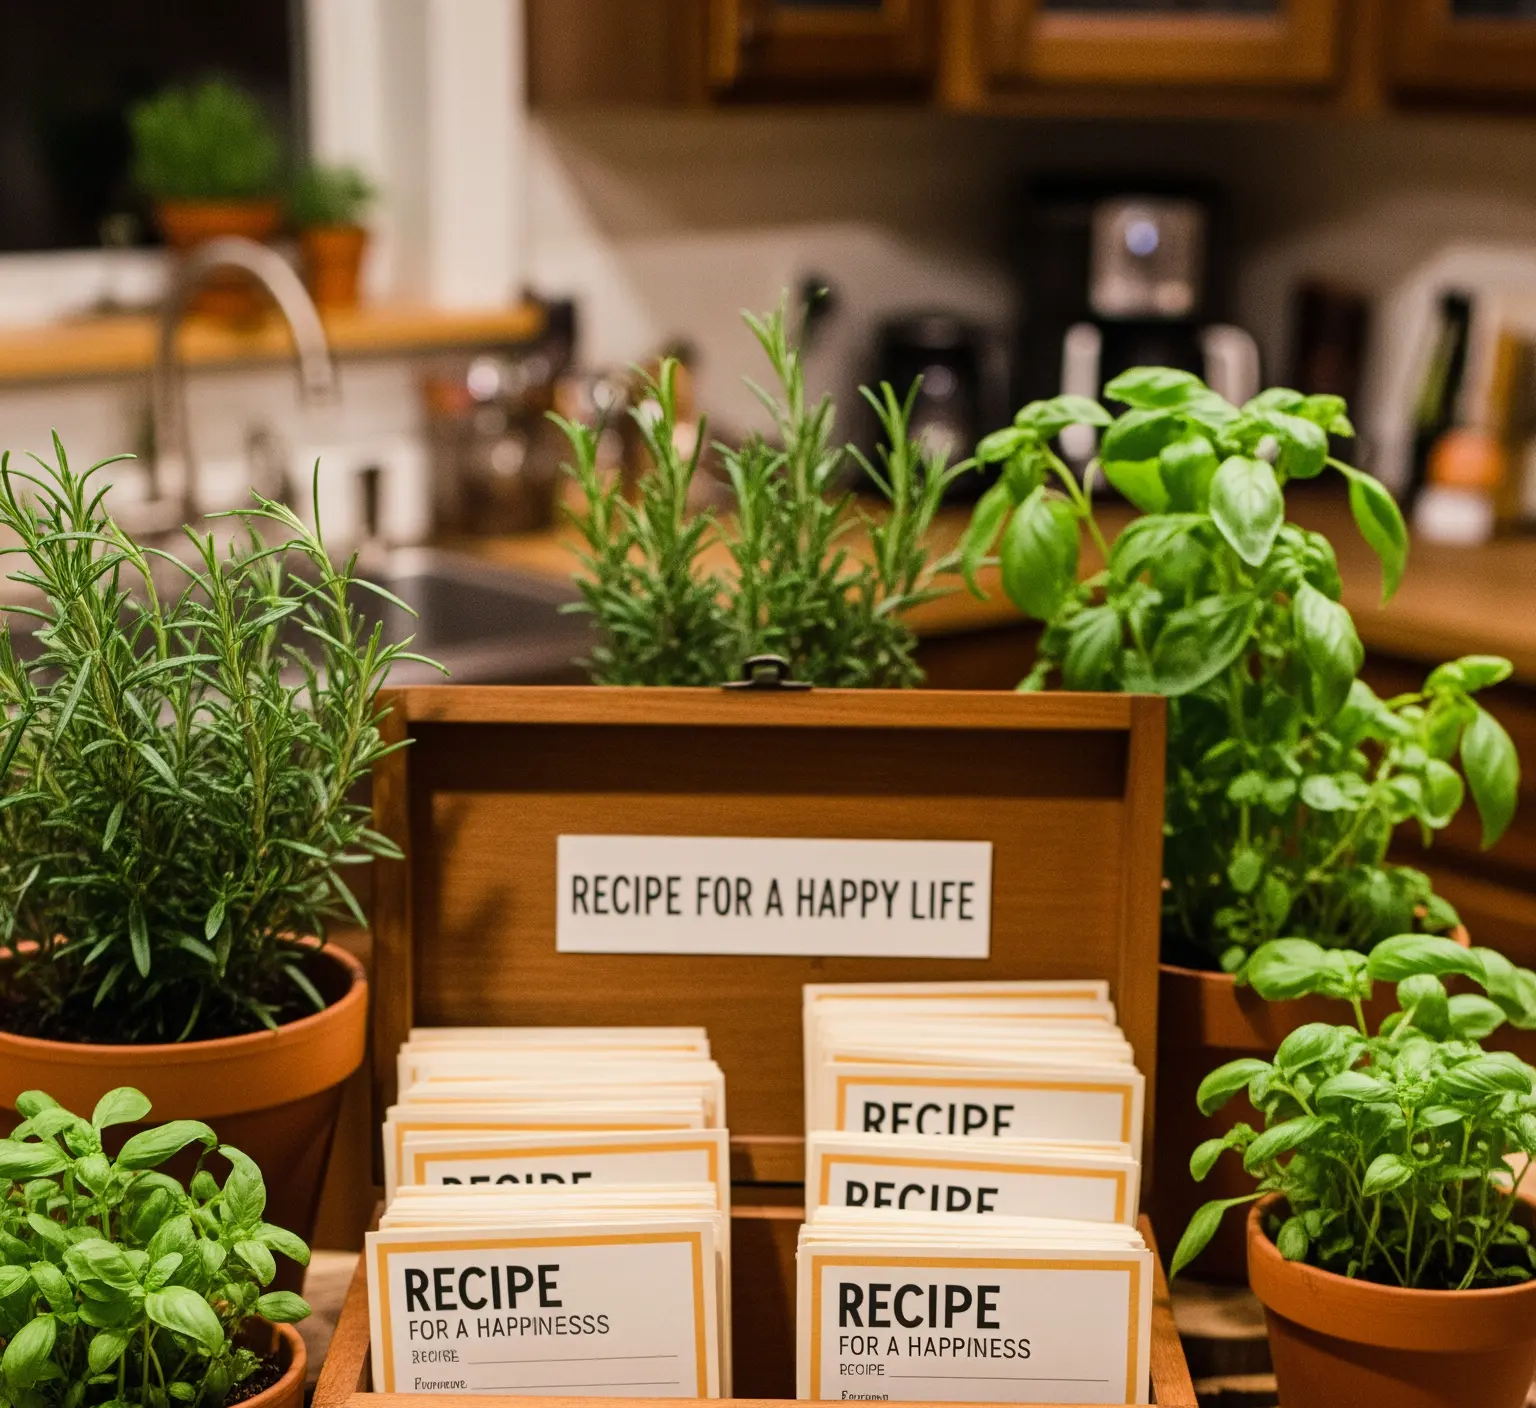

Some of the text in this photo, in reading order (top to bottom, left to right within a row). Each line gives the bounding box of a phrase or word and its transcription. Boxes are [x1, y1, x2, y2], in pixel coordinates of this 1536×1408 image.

[571, 875, 975, 920] RECIPE FOR A HAPPY LIFE
[862, 1101, 1015, 1137] RECIPE
[404, 1264, 563, 1313] RECIPE
[838, 1282, 1001, 1330] RECIPE
[408, 1318, 450, 1341] FOR
[455, 1318, 469, 1339] A
[838, 1335, 1032, 1360] FOR A HAPPINESS
